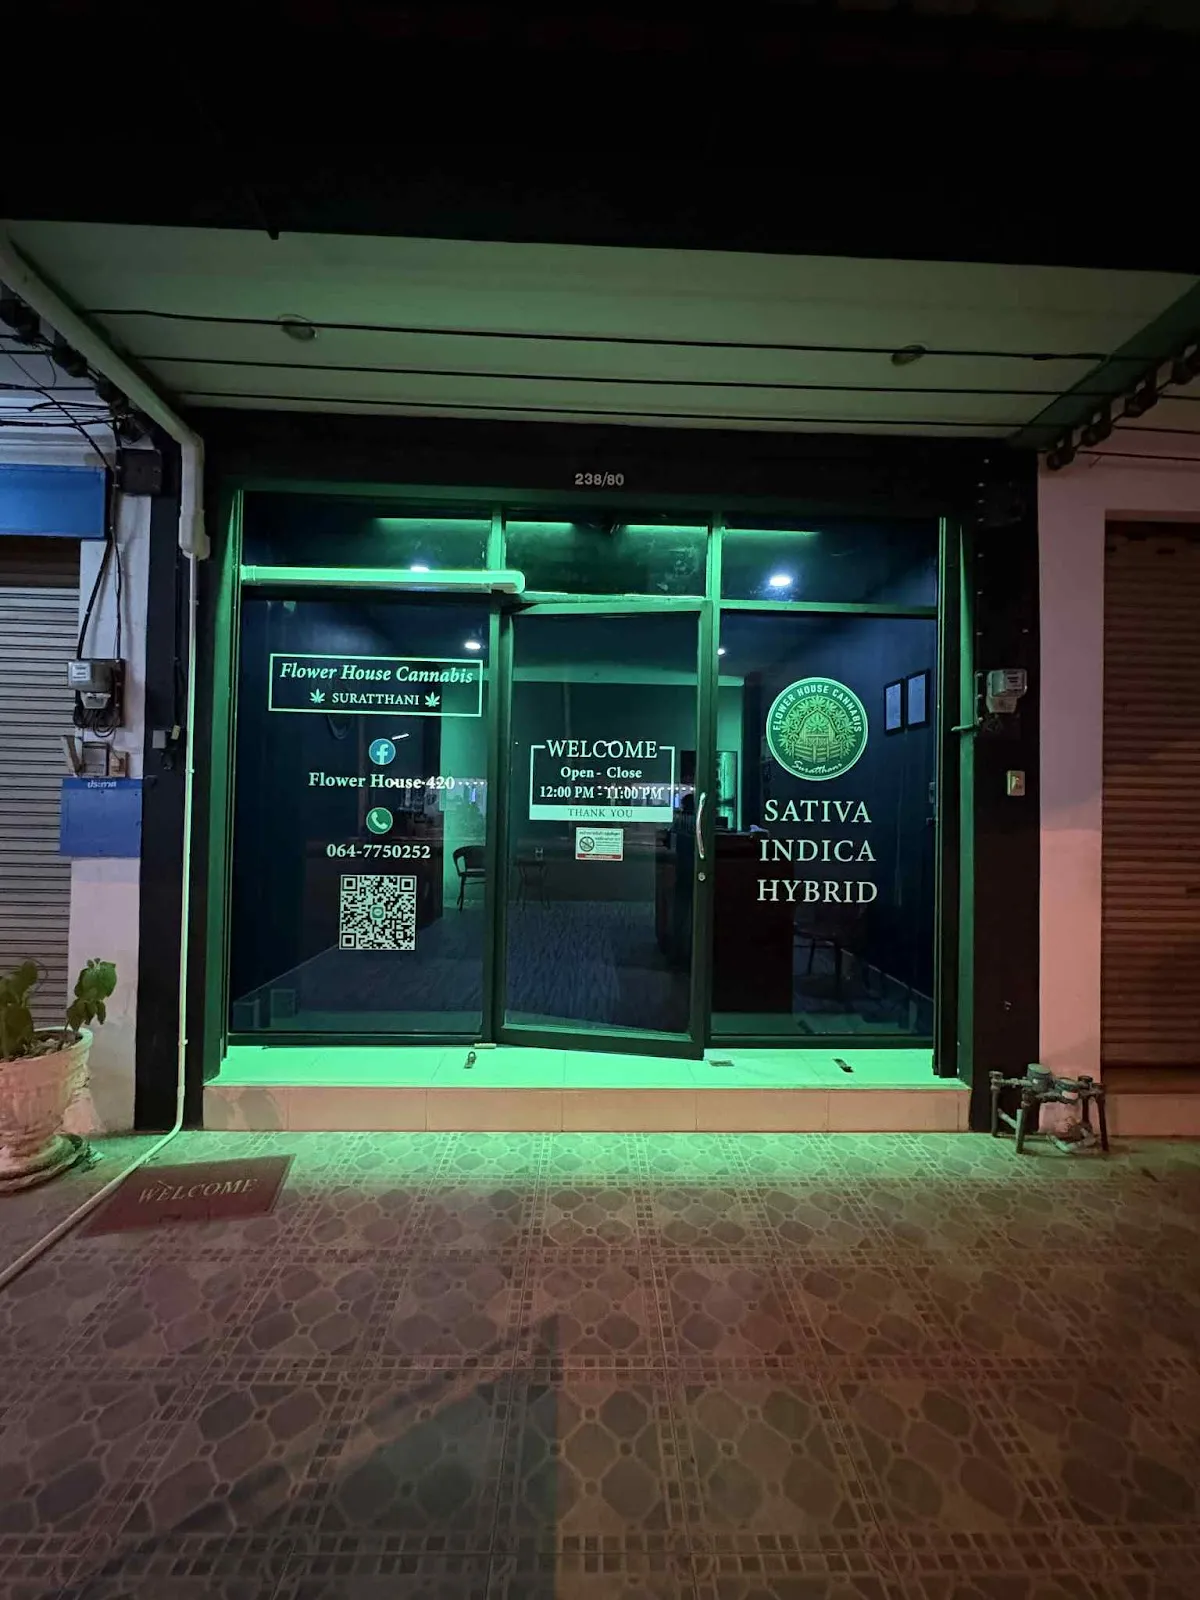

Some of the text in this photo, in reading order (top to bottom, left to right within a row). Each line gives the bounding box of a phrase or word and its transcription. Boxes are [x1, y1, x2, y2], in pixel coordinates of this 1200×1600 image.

[575, 472, 624, 487] 238/80
[280, 662, 474, 683] Flower House Cannabis
[331, 692, 420, 706] SURATTHANI
[773, 684, 862, 733] FLOWER HOUSE CANNABIS
[546, 739, 658, 758] WELCOME
[308, 772, 455, 789] Flower House 420
[606, 767, 642, 778] Close
[539, 786, 571, 798] 12:00
[574, 786, 594, 798] PM
[606, 787, 638, 799] 11:00
[642, 787, 663, 800] PM
[568, 808, 633, 818] THANK YOU
[764, 799, 872, 823] SATIVA
[326, 844, 431, 859] 064-7750252
[759, 839, 877, 862] INDICA
[757, 879, 878, 903] HYBRID
[138, 1179, 258, 1203] WELCOME
